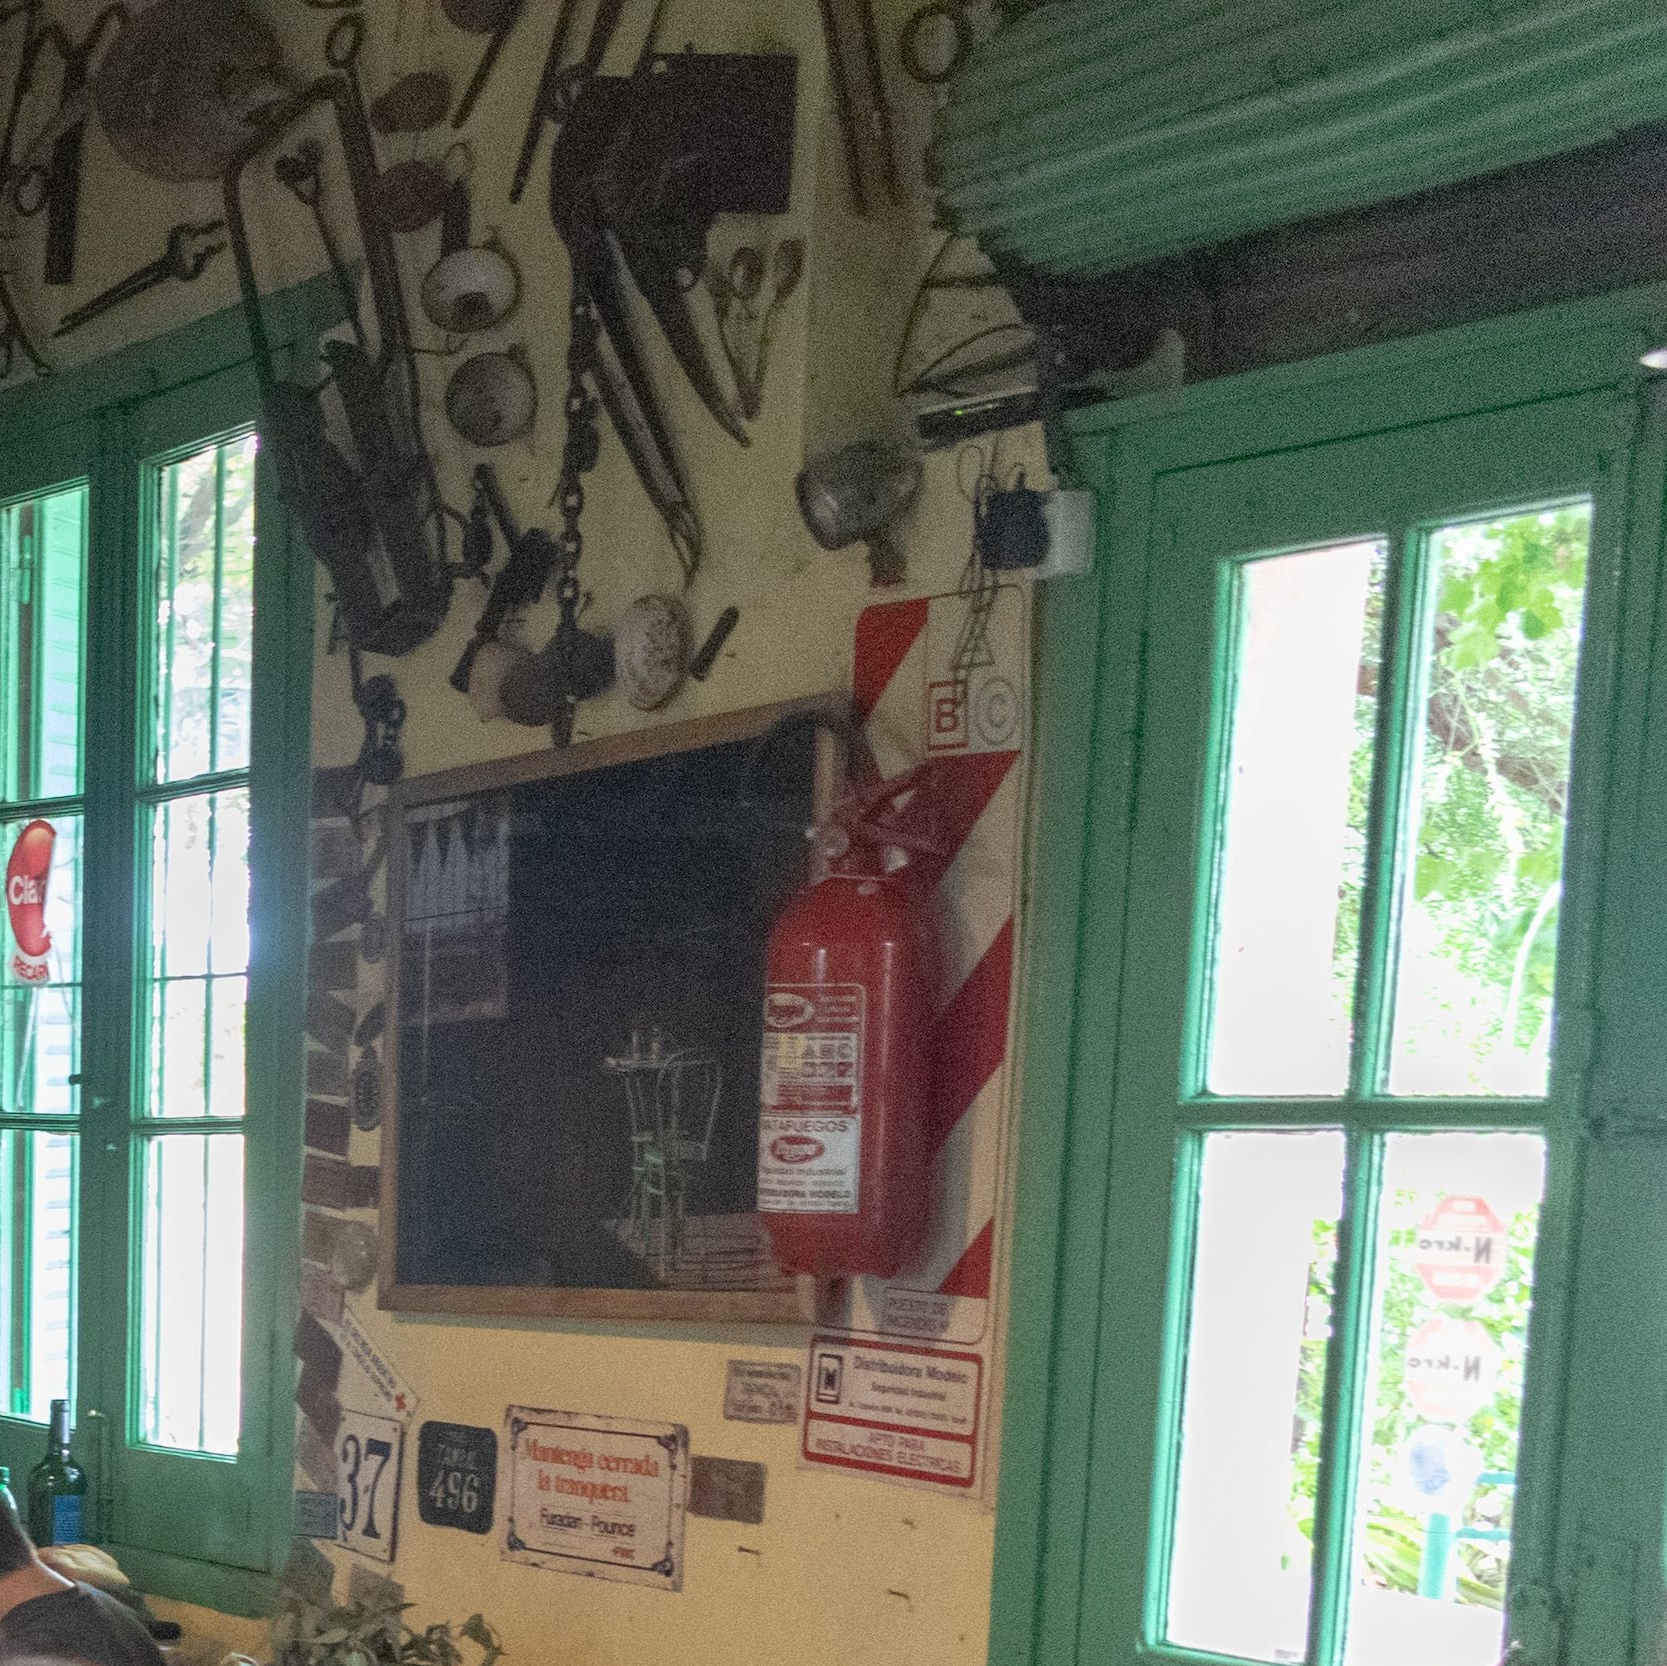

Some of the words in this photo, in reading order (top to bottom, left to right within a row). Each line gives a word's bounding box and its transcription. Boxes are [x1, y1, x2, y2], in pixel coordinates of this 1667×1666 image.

[935, 698, 960, 734] B
[526, 1437, 594, 1475] Mantenga
[597, 1454, 660, 1478] cerrada
[339, 1433, 393, 1541] 37
[429, 1470, 481, 1514] 496
[537, 1468, 551, 1493] la
[590, 1514, 637, 1538] Pounce
